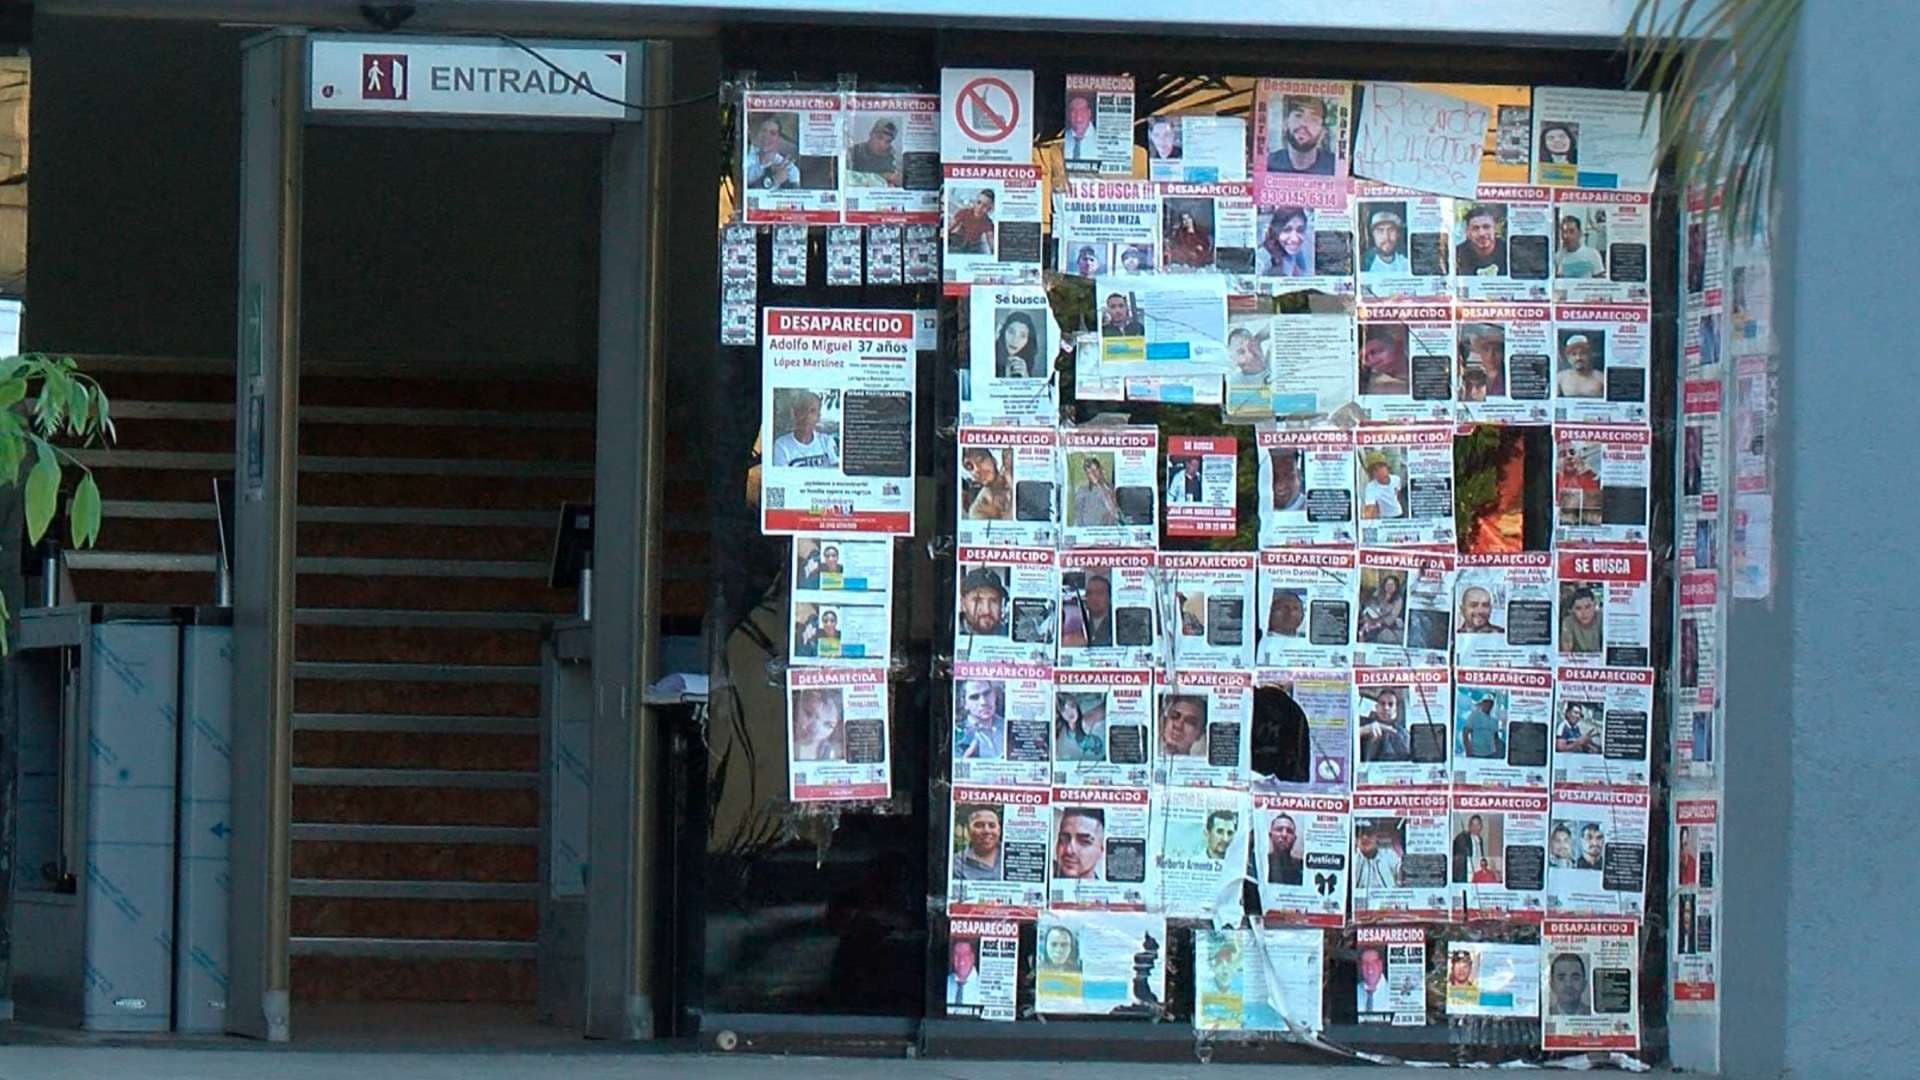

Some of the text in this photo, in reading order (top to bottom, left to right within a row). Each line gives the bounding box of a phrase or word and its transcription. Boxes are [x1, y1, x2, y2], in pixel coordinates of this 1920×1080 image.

[430, 67, 595, 95] ENTRADA
[1066, 76, 1134, 90] DESAPARECIDO
[1264, 80, 1345, 95] Desaparecido
[753, 99, 834, 109] DESAPARECIDO
[852, 99, 935, 110] DESAPARECIDO
[952, 167, 1036, 178] DESAPARECIDO
[1081, 182, 1095, 199] SE
[1098, 183, 1141, 200] BUSCA
[1560, 191, 1642, 202] DESAPARECIDO
[1064, 202, 1157, 214] CARLOS MAXIMILIANO
[1079, 214, 1141, 225] ROMERO MEZA
[995, 294, 1047, 304] Se busca
[1366, 308, 1446, 318] DESAPARECIDO
[1461, 308, 1544, 318] DESAPARECIDO
[1562, 310, 1641, 321] DESAPARECIDO
[780, 315, 903, 332] DESAPARECIDO
[769, 338, 908, 355] Adolfo Miguel 37 años
[774, 357, 844, 370] López Martínez
[967, 433, 1049, 444] DESAPARECIDO
[1066, 435, 1148, 446] DESAPARECIDO
[1264, 433, 1348, 443] DESAPARECIDOS
[1363, 432, 1444, 443] DESAPARECIDO
[1560, 430, 1645, 441] DESAPARECIDOS
[967, 550, 1049, 562] DESAPARECIDO
[1066, 556, 1148, 567] DESAPARECIDO
[1165, 556, 1247, 567] DESAPARECIDO
[1456, 554, 1546, 564] DESAPARECIDO
[1575, 557, 1631, 574] SE BUSCA
[799, 672, 877, 684] DESAPARECIDA
[961, 667, 1045, 678] DESAPARECIDO
[1362, 672, 1441, 683] DESAPARECIDO
[1566, 669, 1646, 682] DESAPARECIDO
[1060, 673, 1141, 684] DESAPARECIDA
[1465, 672, 1546, 685] DESAPARECIDO
[960, 790, 1042, 803] DESAPARECIDO
[1060, 790, 1141, 801] DESAPARECIDO
[1560, 790, 1643, 804] DESAPARECIDO
[1263, 798, 1343, 810] DESAPARECIDO
[1359, 797, 1445, 806] DESAPARECIDOS
[1461, 797, 1541, 808] DESAPARECIDO
[1308, 854, 1341, 865] Justicia
[950, 920, 1018, 935] DESAPARECIDO
[1551, 923, 1628, 933] DESAPARECIDO
[1357, 928, 1424, 942] DESAPARECIDO
